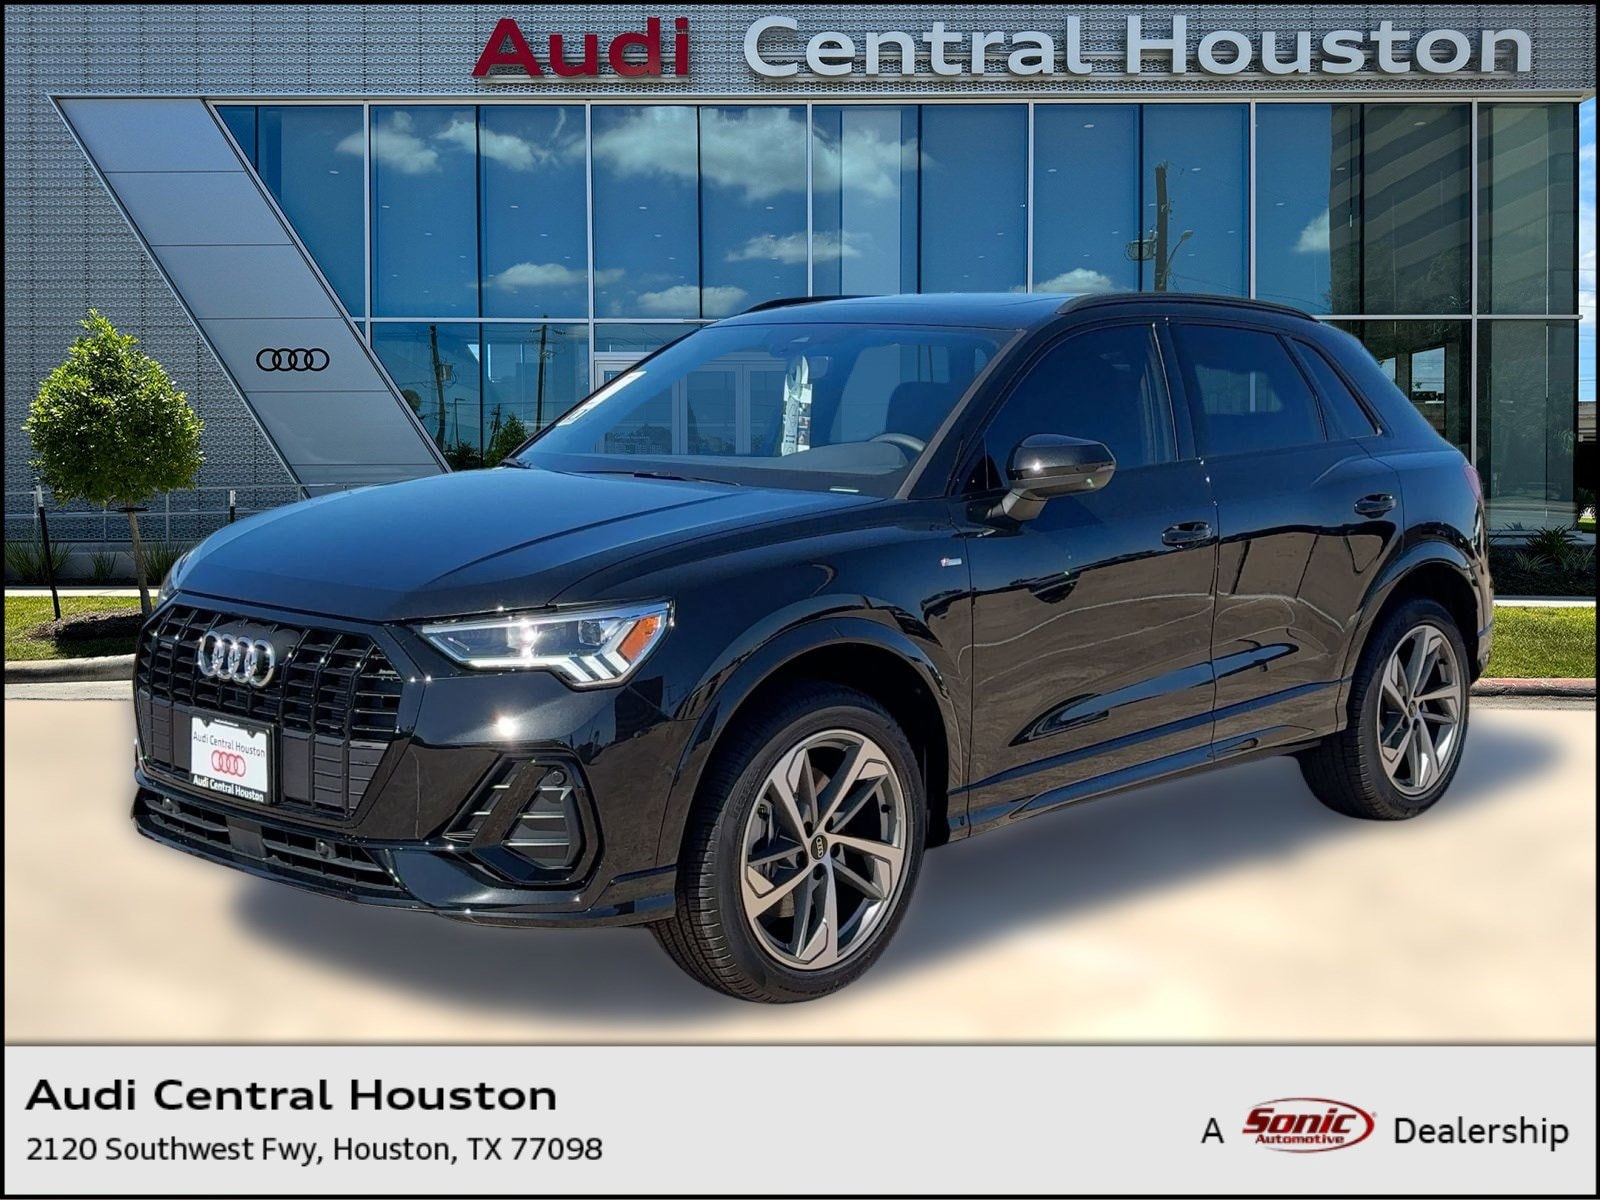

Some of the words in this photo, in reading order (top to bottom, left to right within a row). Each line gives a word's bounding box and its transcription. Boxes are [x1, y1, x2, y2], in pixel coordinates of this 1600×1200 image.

[472, 17, 689, 77] Audi
[743, 15, 1093, 77] Central
[1126, 14, 1532, 75] Houston
[193, 731, 209, 744] Audi
[209, 735, 234, 751] Central
[235, 741, 265, 757] Houston
[193, 774, 209, 788] Audi
[209, 779, 235, 795] Central
[235, 785, 264, 803] Houston
